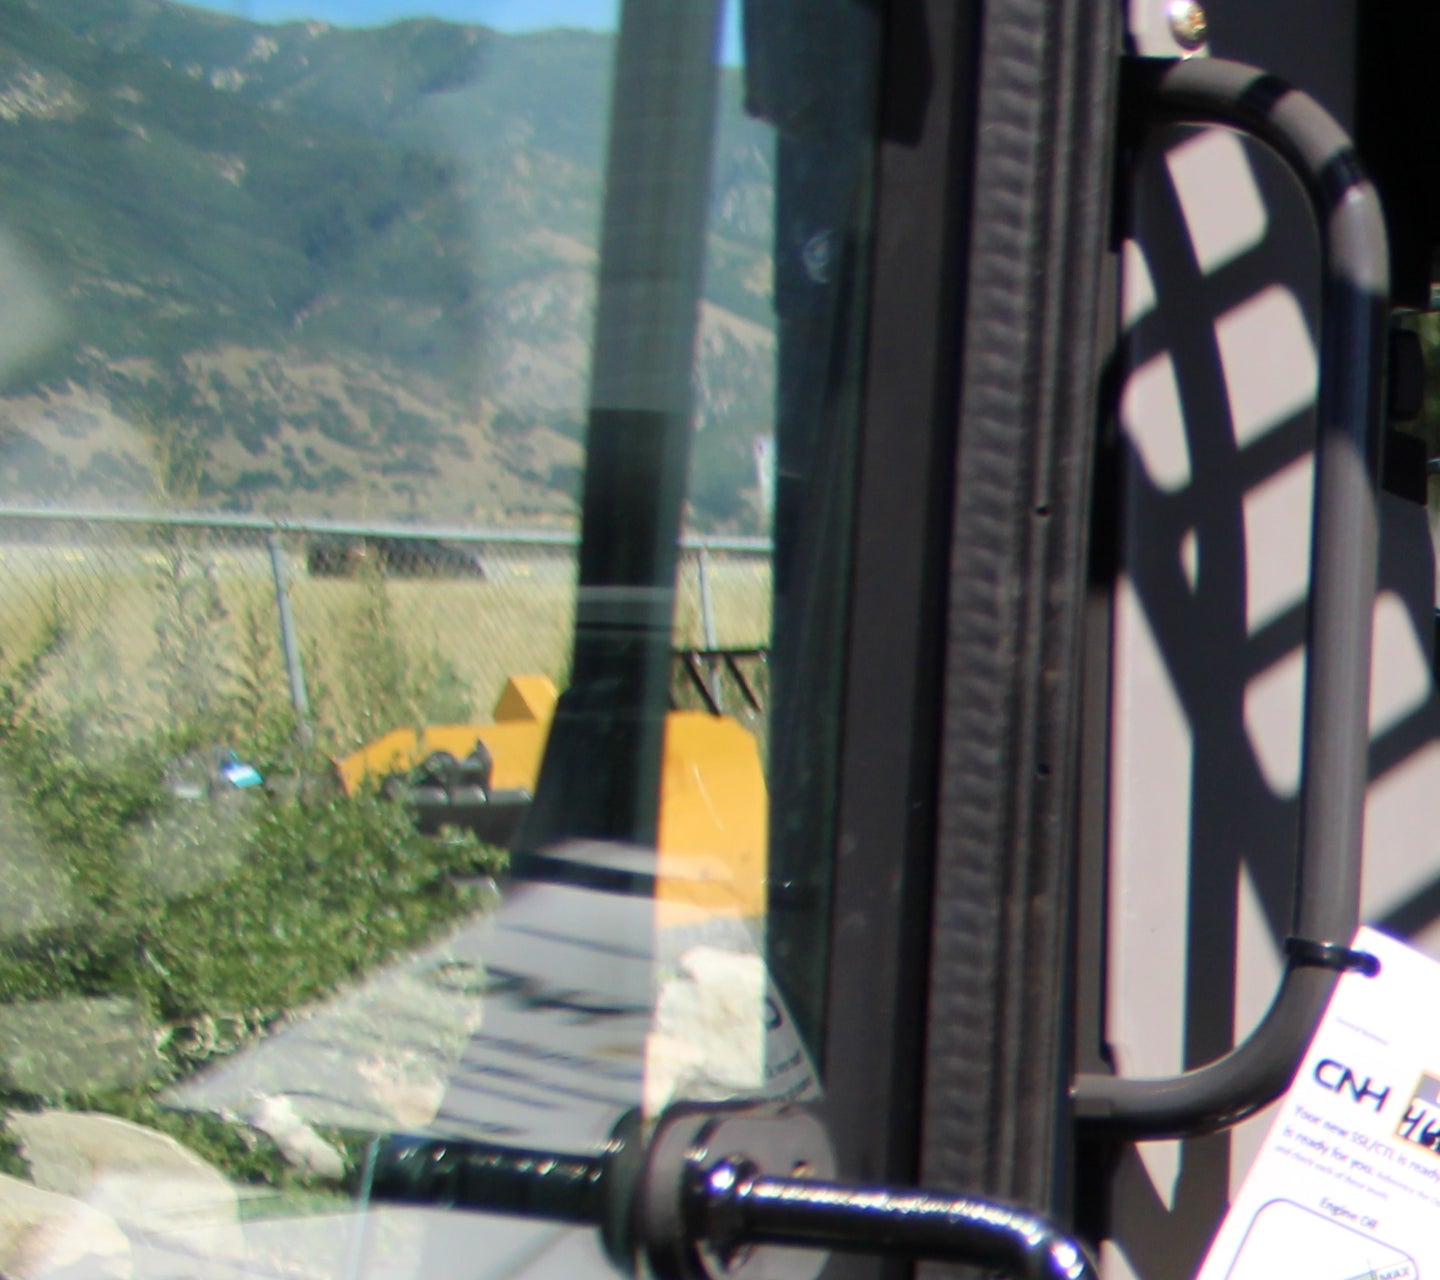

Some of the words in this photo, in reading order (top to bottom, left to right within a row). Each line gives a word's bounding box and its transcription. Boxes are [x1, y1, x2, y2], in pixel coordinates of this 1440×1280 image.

[1313, 1058, 1390, 1112] CNH
[1283, 1126, 1294, 1137] is
[1296, 1133, 1329, 1155] ready
[1331, 1147, 1349, 1161] for
[1295, 1105, 1323, 1124] Your
[1323, 1121, 1349, 1137] new
[1397, 1154, 1407, 1165] is
